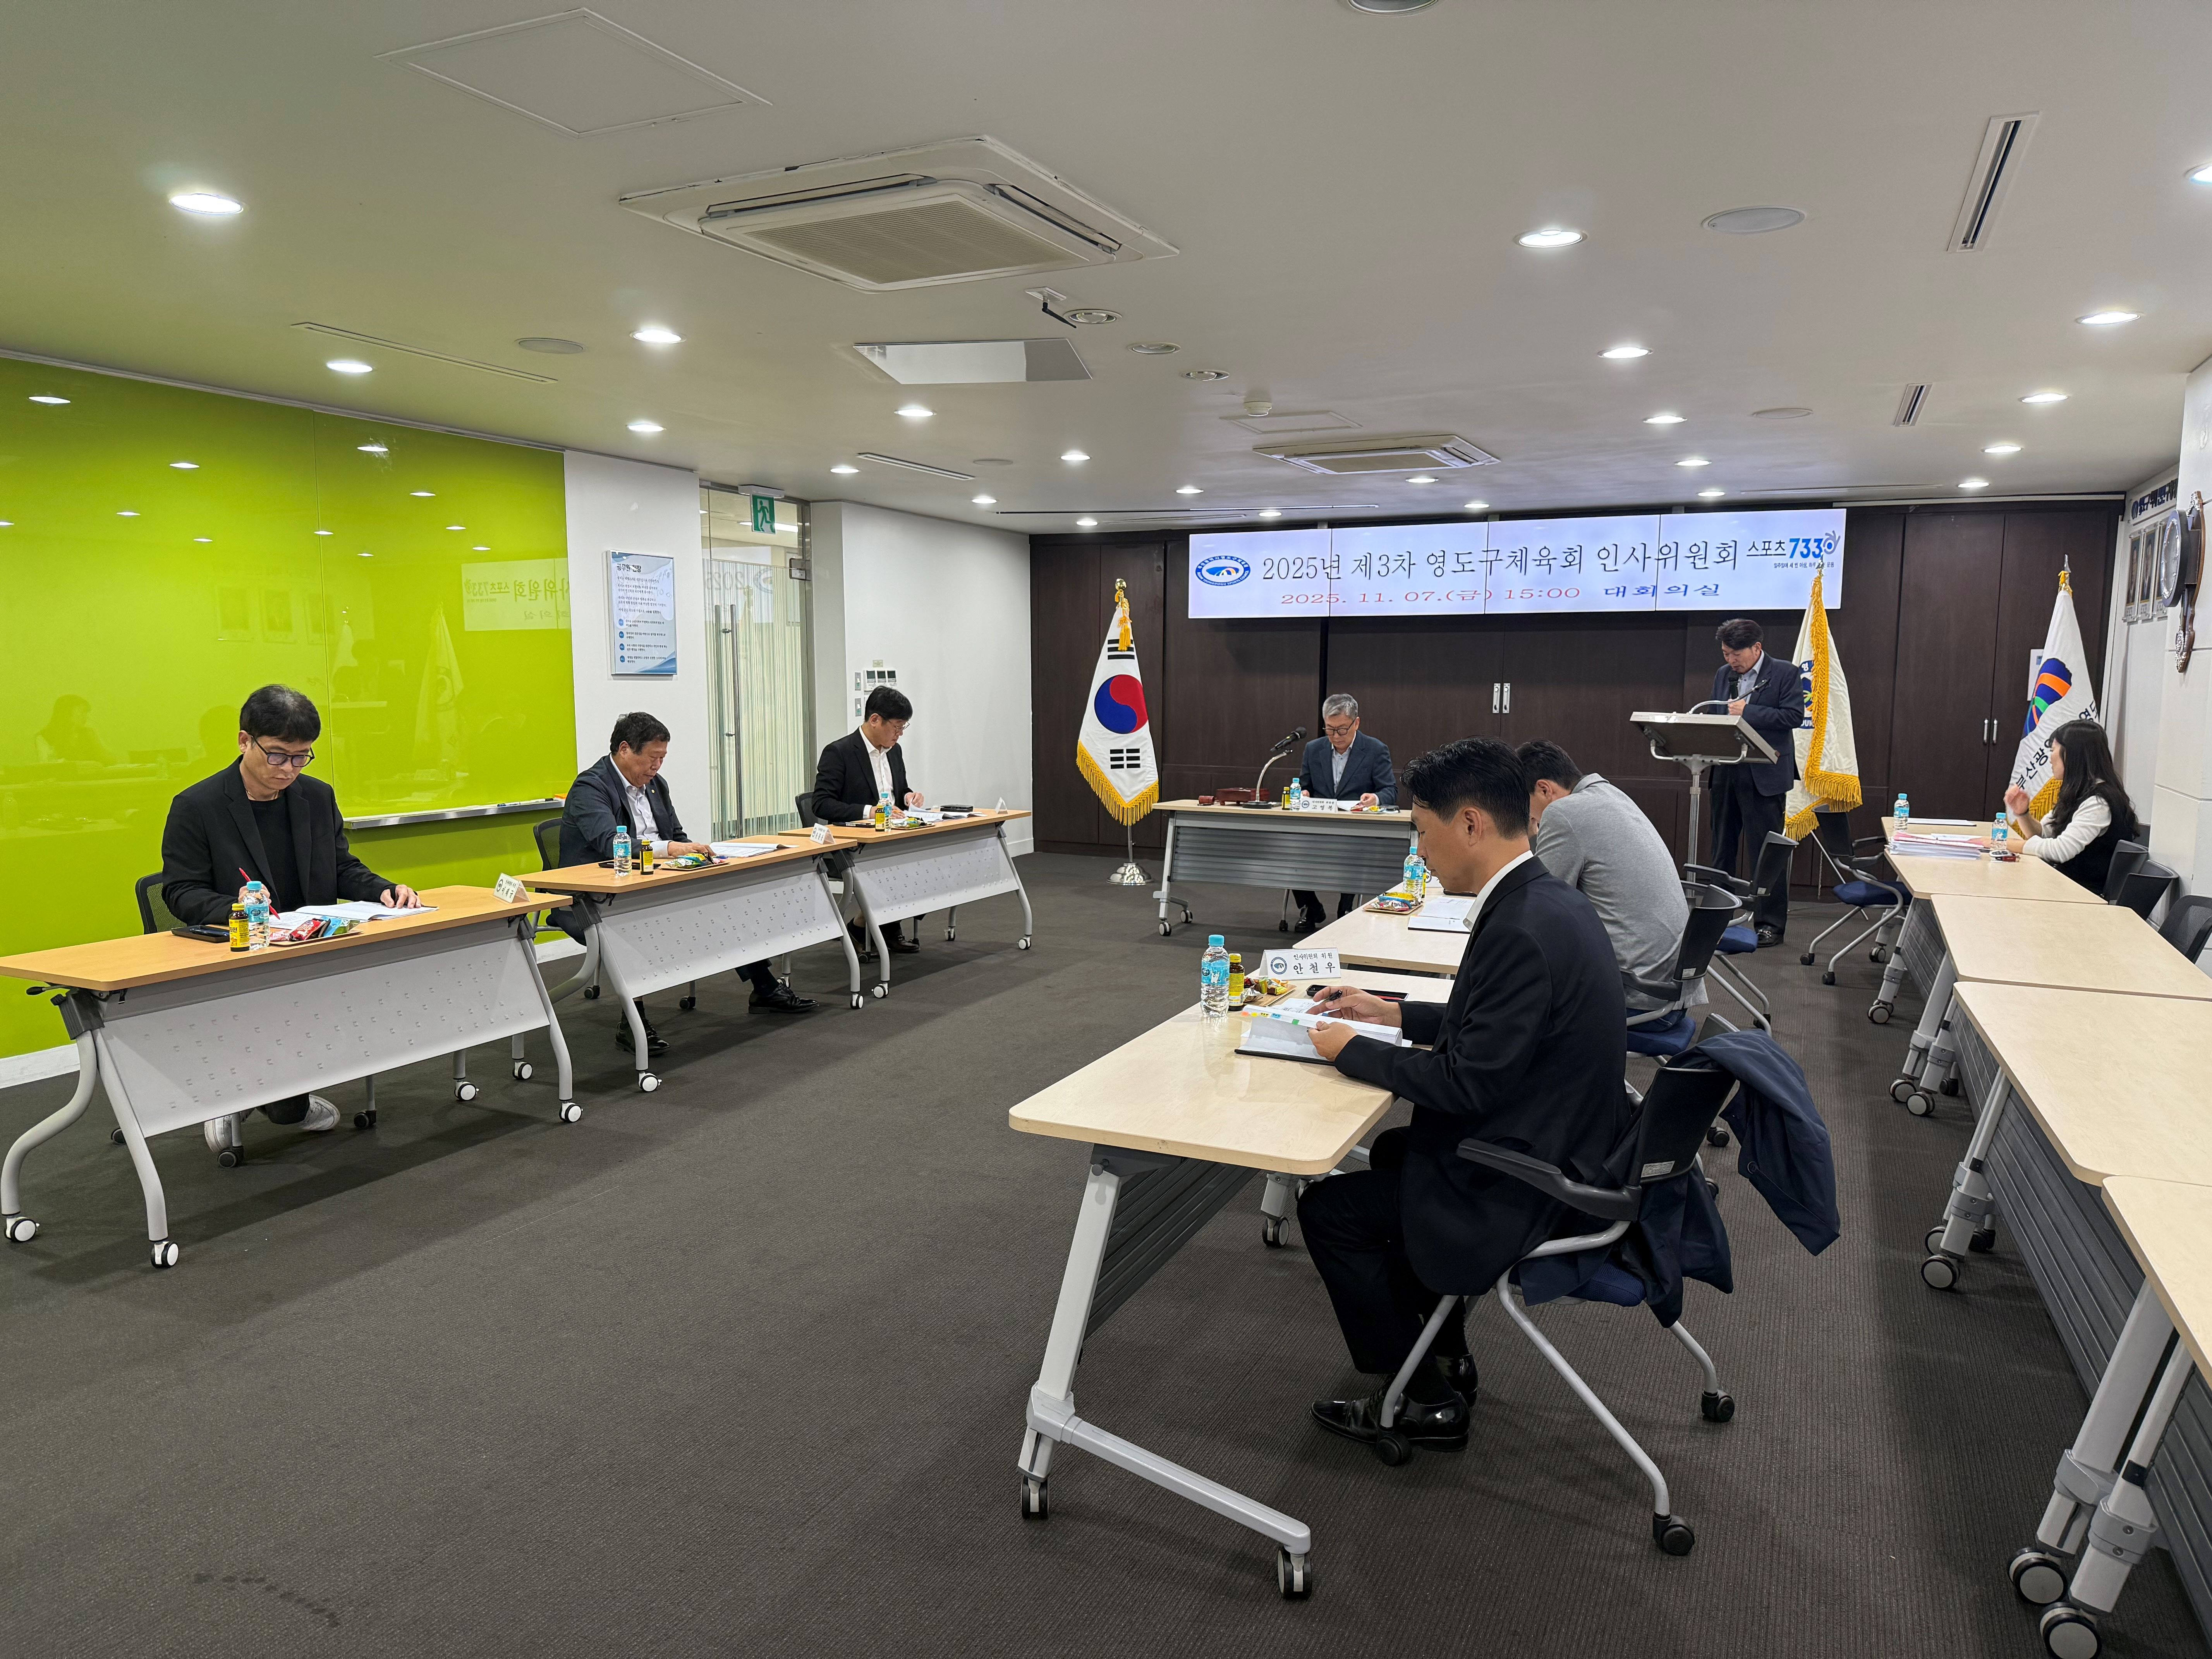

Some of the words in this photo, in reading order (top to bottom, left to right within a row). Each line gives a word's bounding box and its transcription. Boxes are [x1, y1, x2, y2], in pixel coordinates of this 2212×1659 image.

[1747, 540, 1786, 557] 스포츠
[1263, 554, 1341, 580] 2025년
[1351, 551, 1416, 580] 제3차
[1427, 544, 1583, 577] 영도구체육회
[1597, 540, 1737, 573] 인사위원회
[1281, 593, 1346, 604] 2025.
[1359, 592, 1393, 603] 11.
[1405, 589, 1492, 602] 07.(금)
[1504, 587, 1580, 600] 15:00
[1603, 584, 1719, 598] 대회의실
